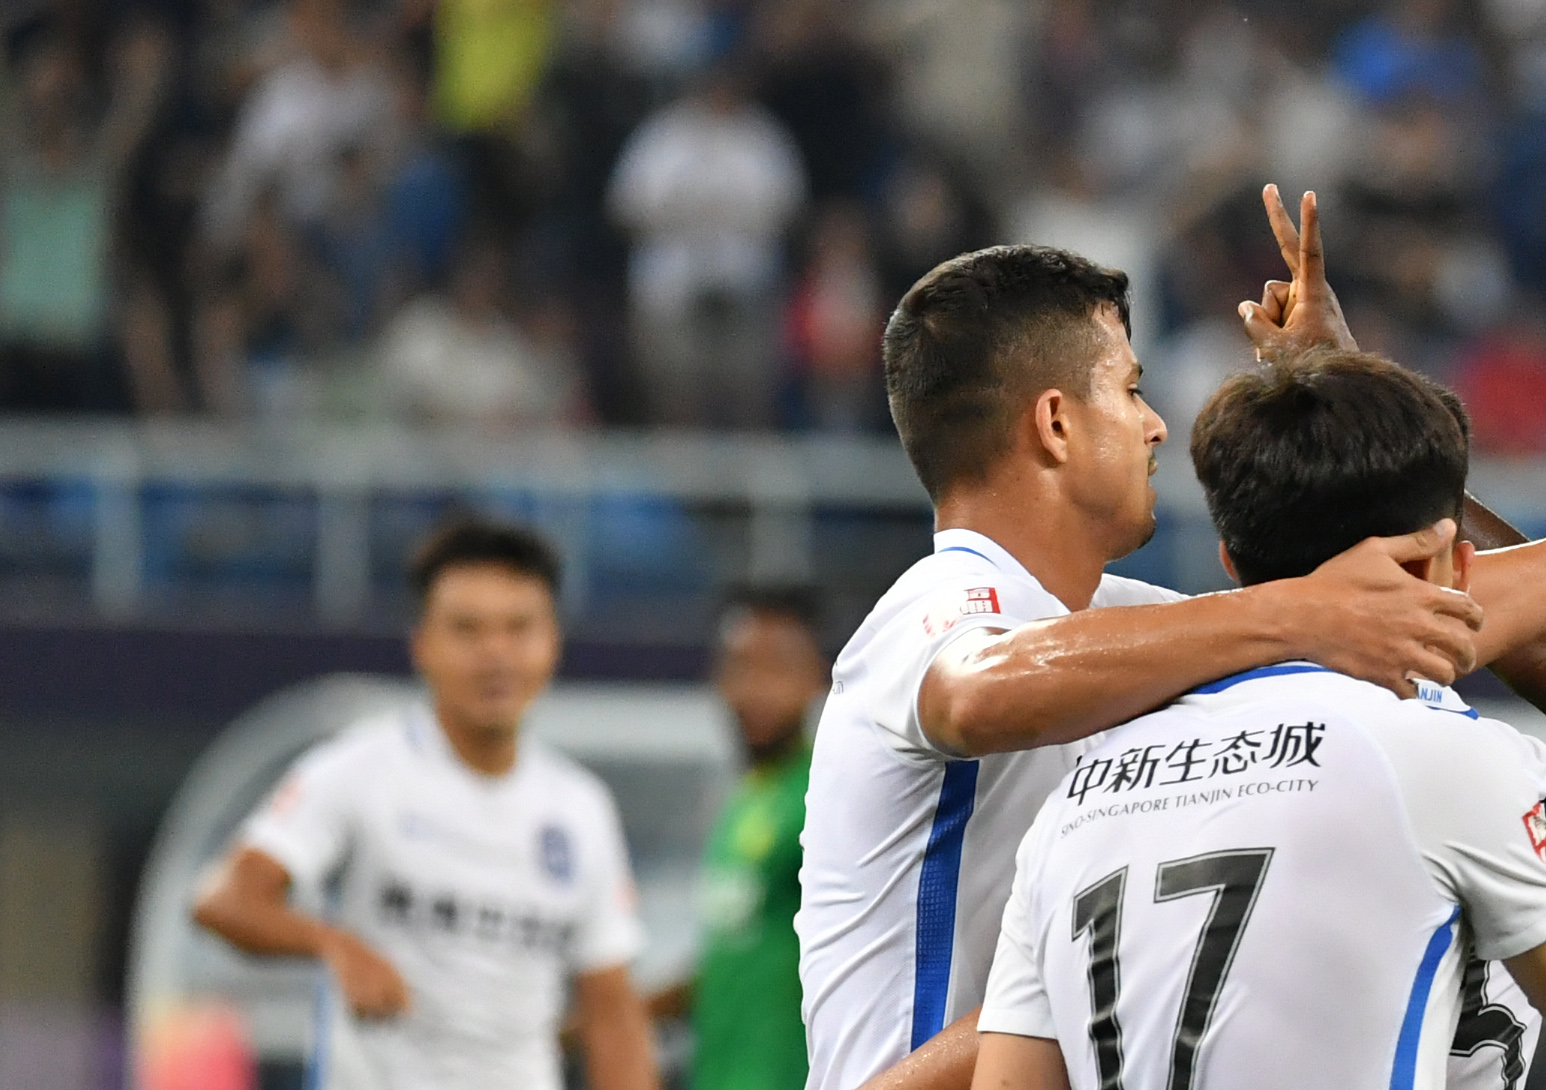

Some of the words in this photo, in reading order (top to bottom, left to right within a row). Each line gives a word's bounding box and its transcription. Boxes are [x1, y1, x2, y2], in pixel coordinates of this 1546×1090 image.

[1066, 721, 1327, 807] 中新生态城
[1174, 787, 1234, 809] TIANJIN
[1237, 778, 1320, 799] ECO-CITY
